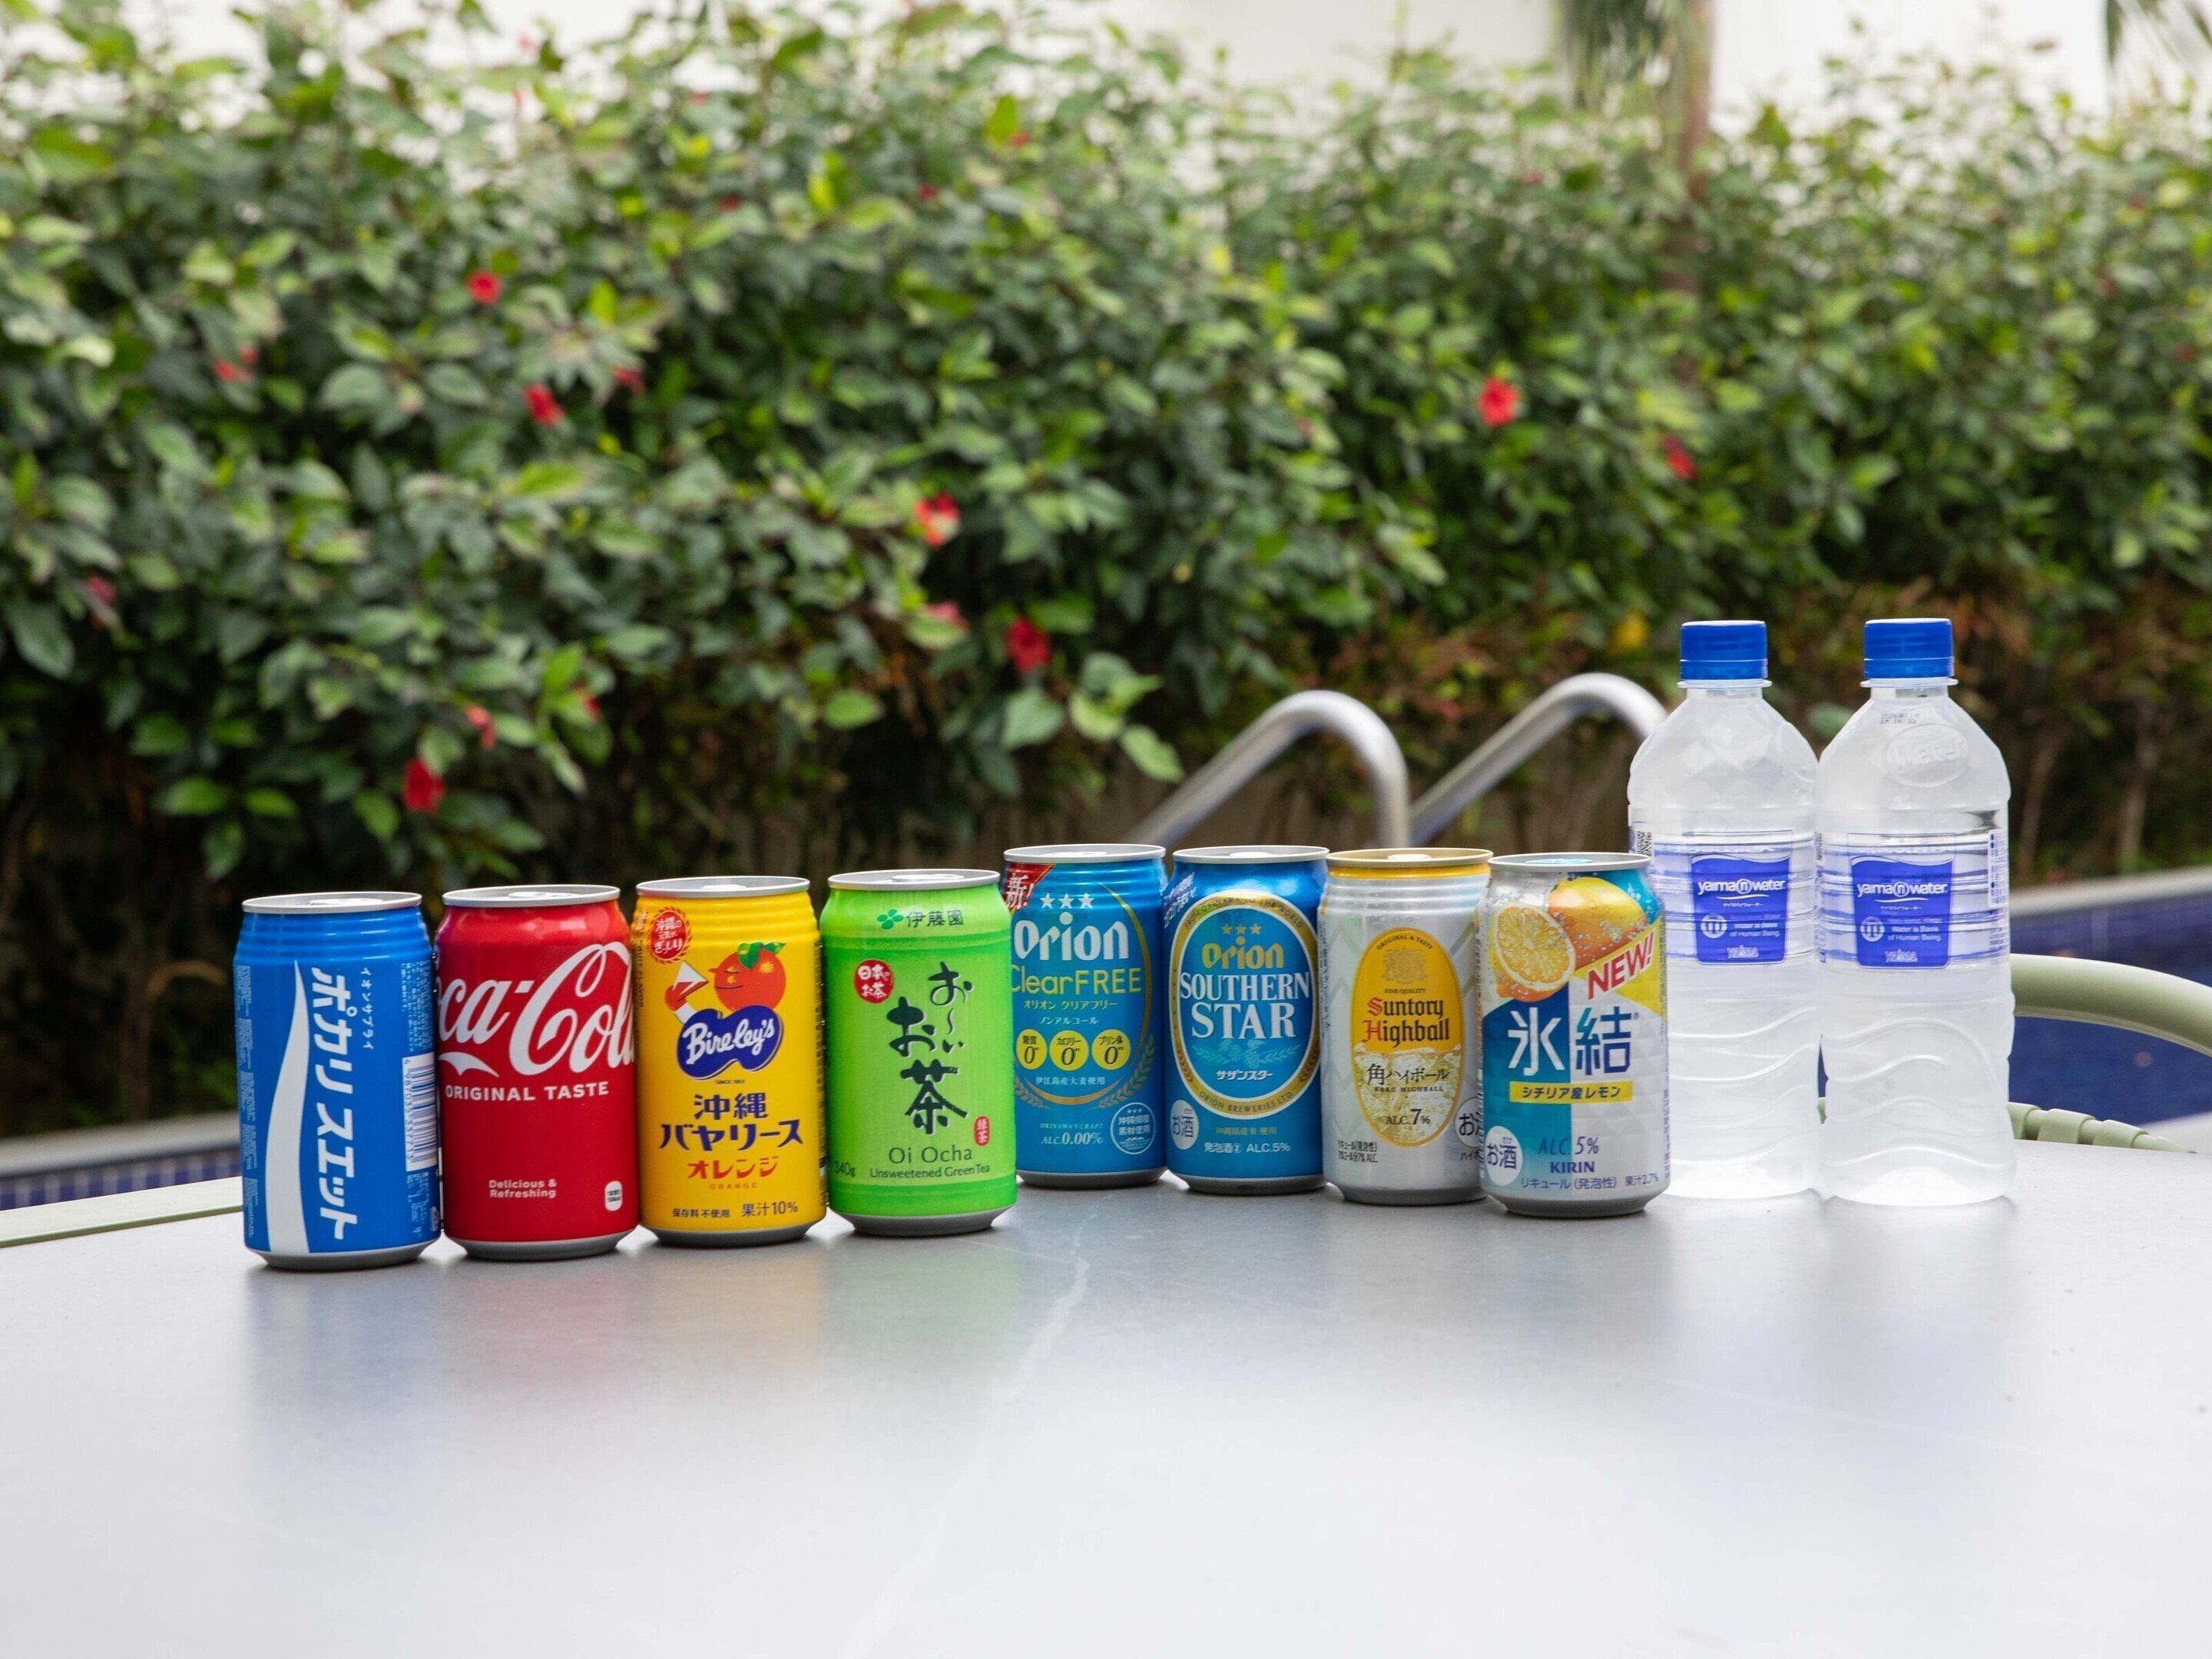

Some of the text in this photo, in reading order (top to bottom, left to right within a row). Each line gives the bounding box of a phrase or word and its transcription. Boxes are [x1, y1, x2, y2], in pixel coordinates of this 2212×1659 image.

[906, 909, 964, 928] 伊藤園
[1014, 912, 1129, 961] Orion
[1202, 935, 1284, 969] Orion
[1588, 931, 1654, 1000] NEW!
[1180, 972, 1310, 1002] SOUTHERN
[360, 967, 374, 1050] イオンサプライ
[1024, 999, 1118, 1010] オリオン クリアフリー
[1368, 997, 1444, 1020] Suntory
[1191, 1002, 1296, 1039] STAR
[682, 1018, 776, 1065] Bireley's
[1362, 1018, 1450, 1048] Highball
[1025, 1046, 1035, 1064] 0
[1061, 1047, 1075, 1065] 0
[1104, 1046, 1118, 1065] 0
[1216, 1069, 1273, 1081] サザンスター
[1366, 1063, 1449, 1085] 角ハイボール
[445, 1081, 609, 1101] ORIGINAL TASTE
[1522, 1087, 1621, 1100] シチリア産レモン
[312, 966, 358, 1240] ポカリスエット
[694, 1092, 768, 1121] 沖縄
[659, 1119, 803, 1151] バヤリース
[889, 1144, 972, 1164] Oi Ocha
[1486, 1145, 1516, 1170] お酒
[687, 1156, 778, 1180] オレンジ
[869, 1164, 990, 1178] Unsweetened Green Tea
[1550, 1161, 1595, 1173] KIRIN
[489, 1179, 556, 1188] Delicious &
[489, 1188, 556, 1199] Refreshing
[710, 1182, 757, 1190] ORANGE
[741, 1200, 798, 1217] 果汁10%
